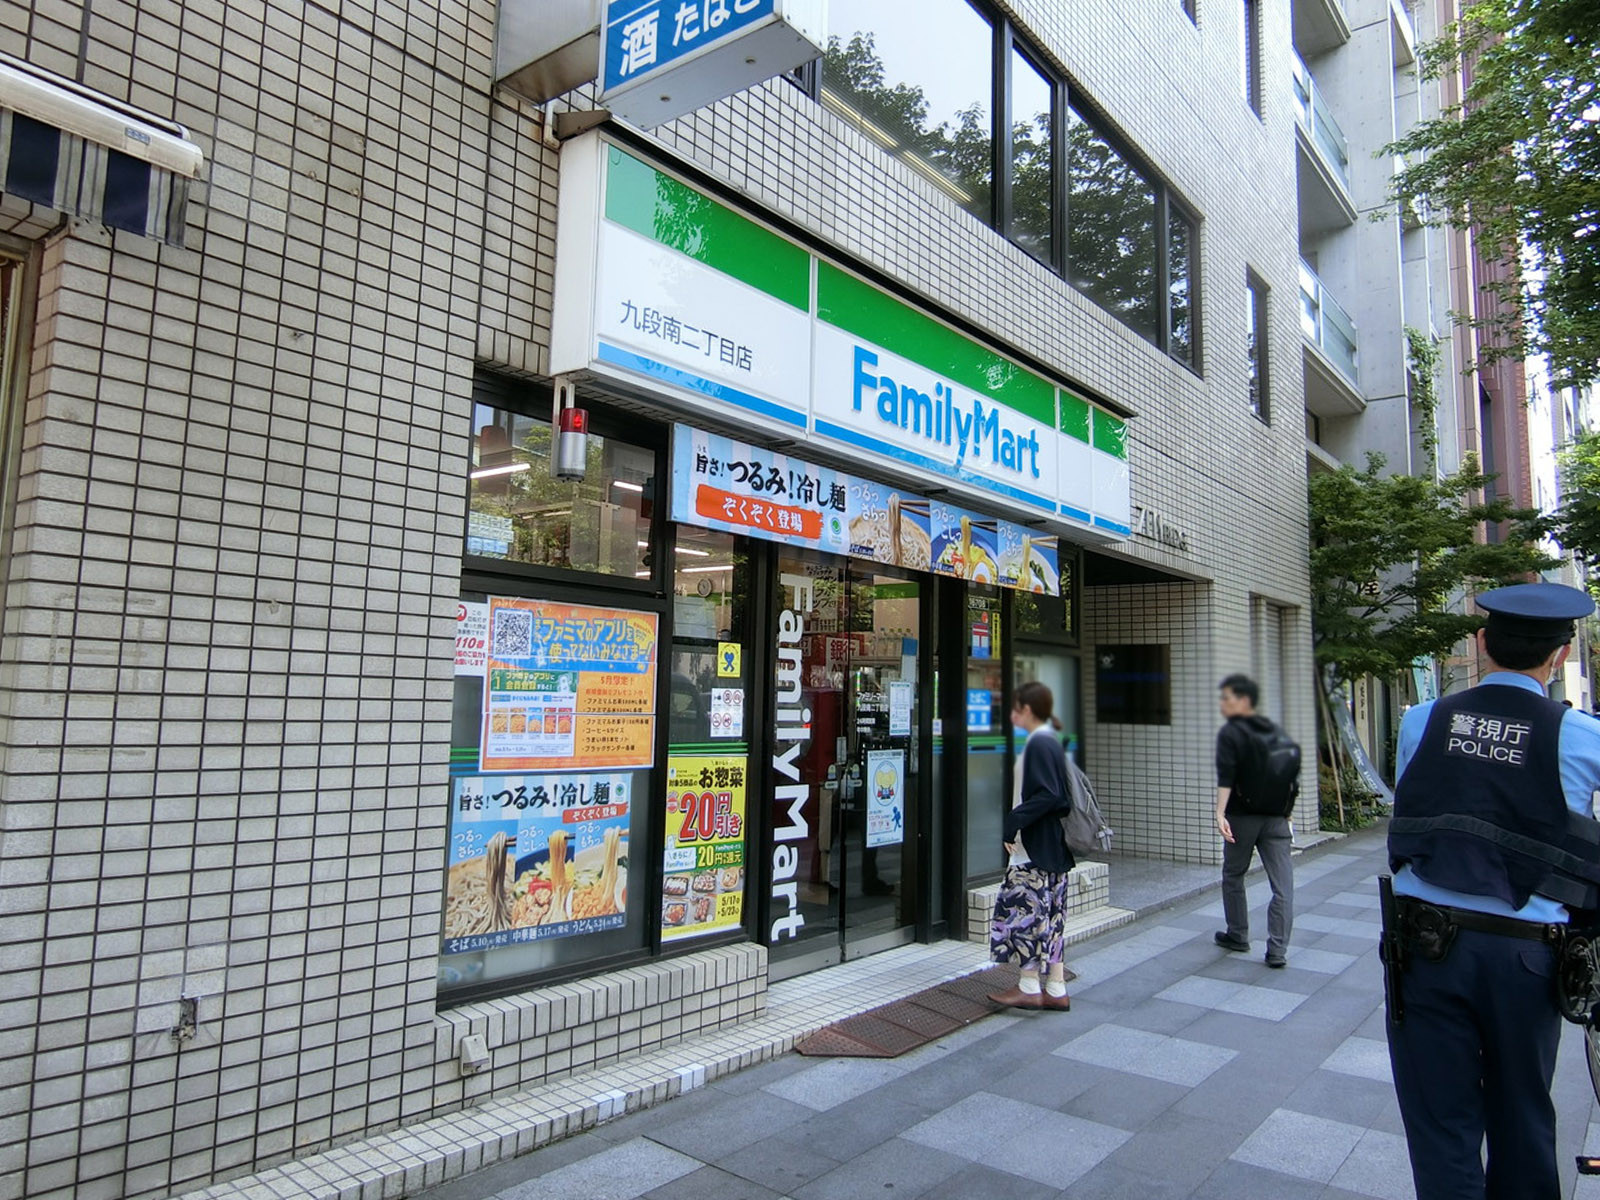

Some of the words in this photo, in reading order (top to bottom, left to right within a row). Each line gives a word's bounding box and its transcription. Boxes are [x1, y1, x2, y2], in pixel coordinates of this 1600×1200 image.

[619, 10, 660, 77] 酒
[620, 299, 753, 372] 九段南二丁目店
[853, 344, 1040, 479] FamilyMart
[770, 572, 814, 942] FamilyMart
[1447, 738, 1524, 765] POLICE
[1450, 713, 1530, 745] 警視庁
[698, 766, 744, 789] お惣菜
